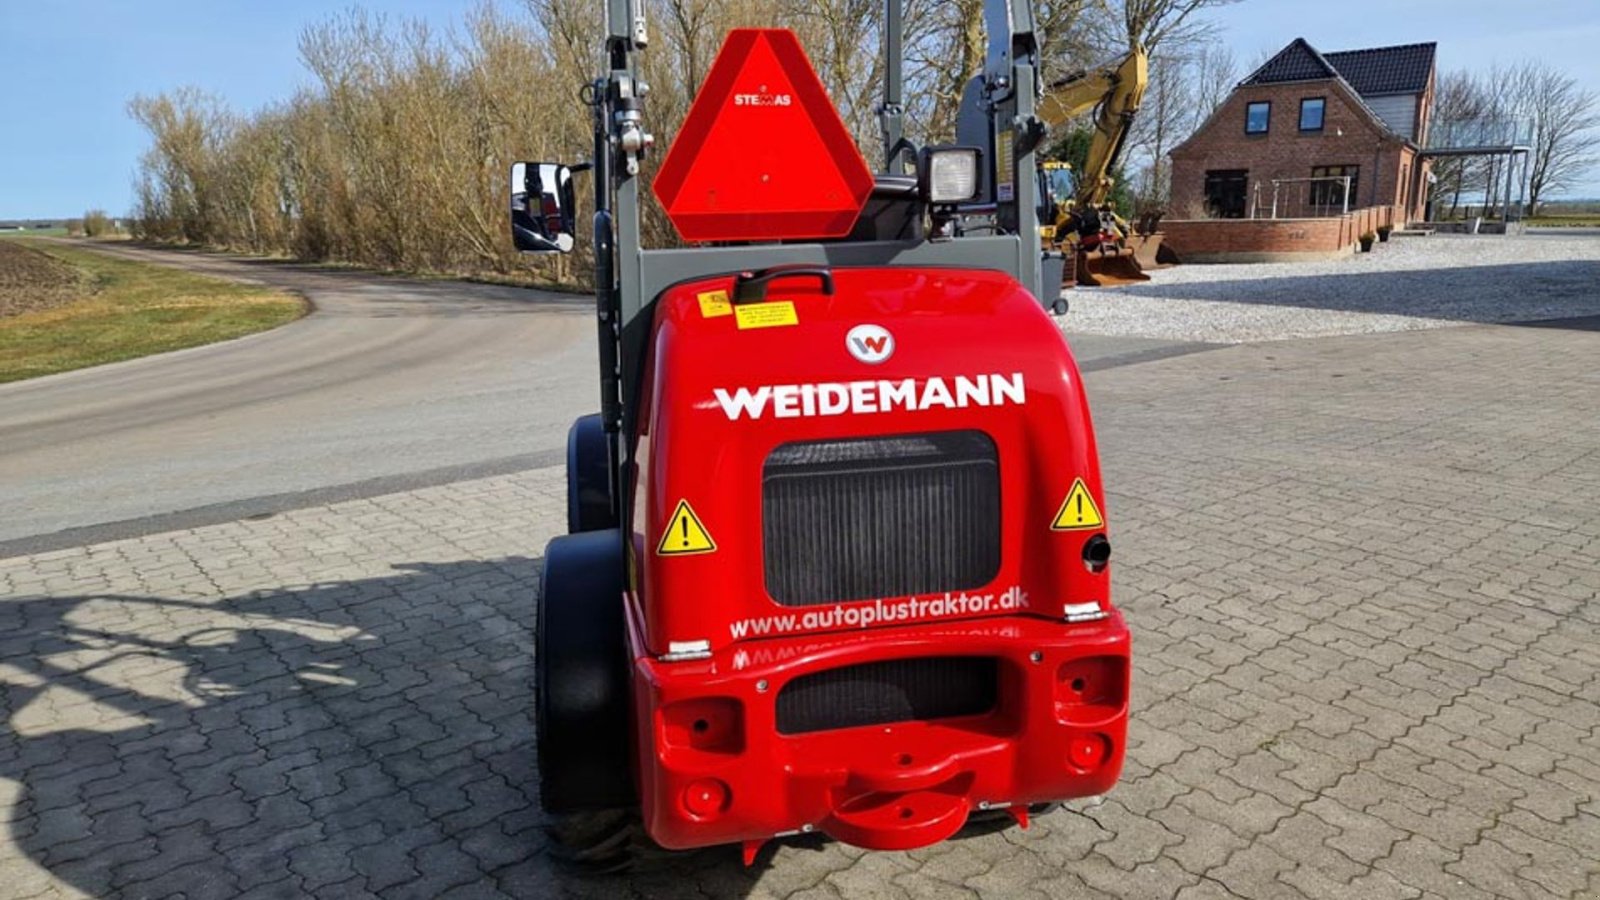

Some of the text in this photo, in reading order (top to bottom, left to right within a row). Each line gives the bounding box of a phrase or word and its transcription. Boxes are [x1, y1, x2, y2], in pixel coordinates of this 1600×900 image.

[734, 94, 791, 106] STEMAS
[852, 336, 888, 354] W
[713, 372, 1026, 420] WEIDEMANN
[730, 586, 1029, 640] www.autoplustraktor.dk
